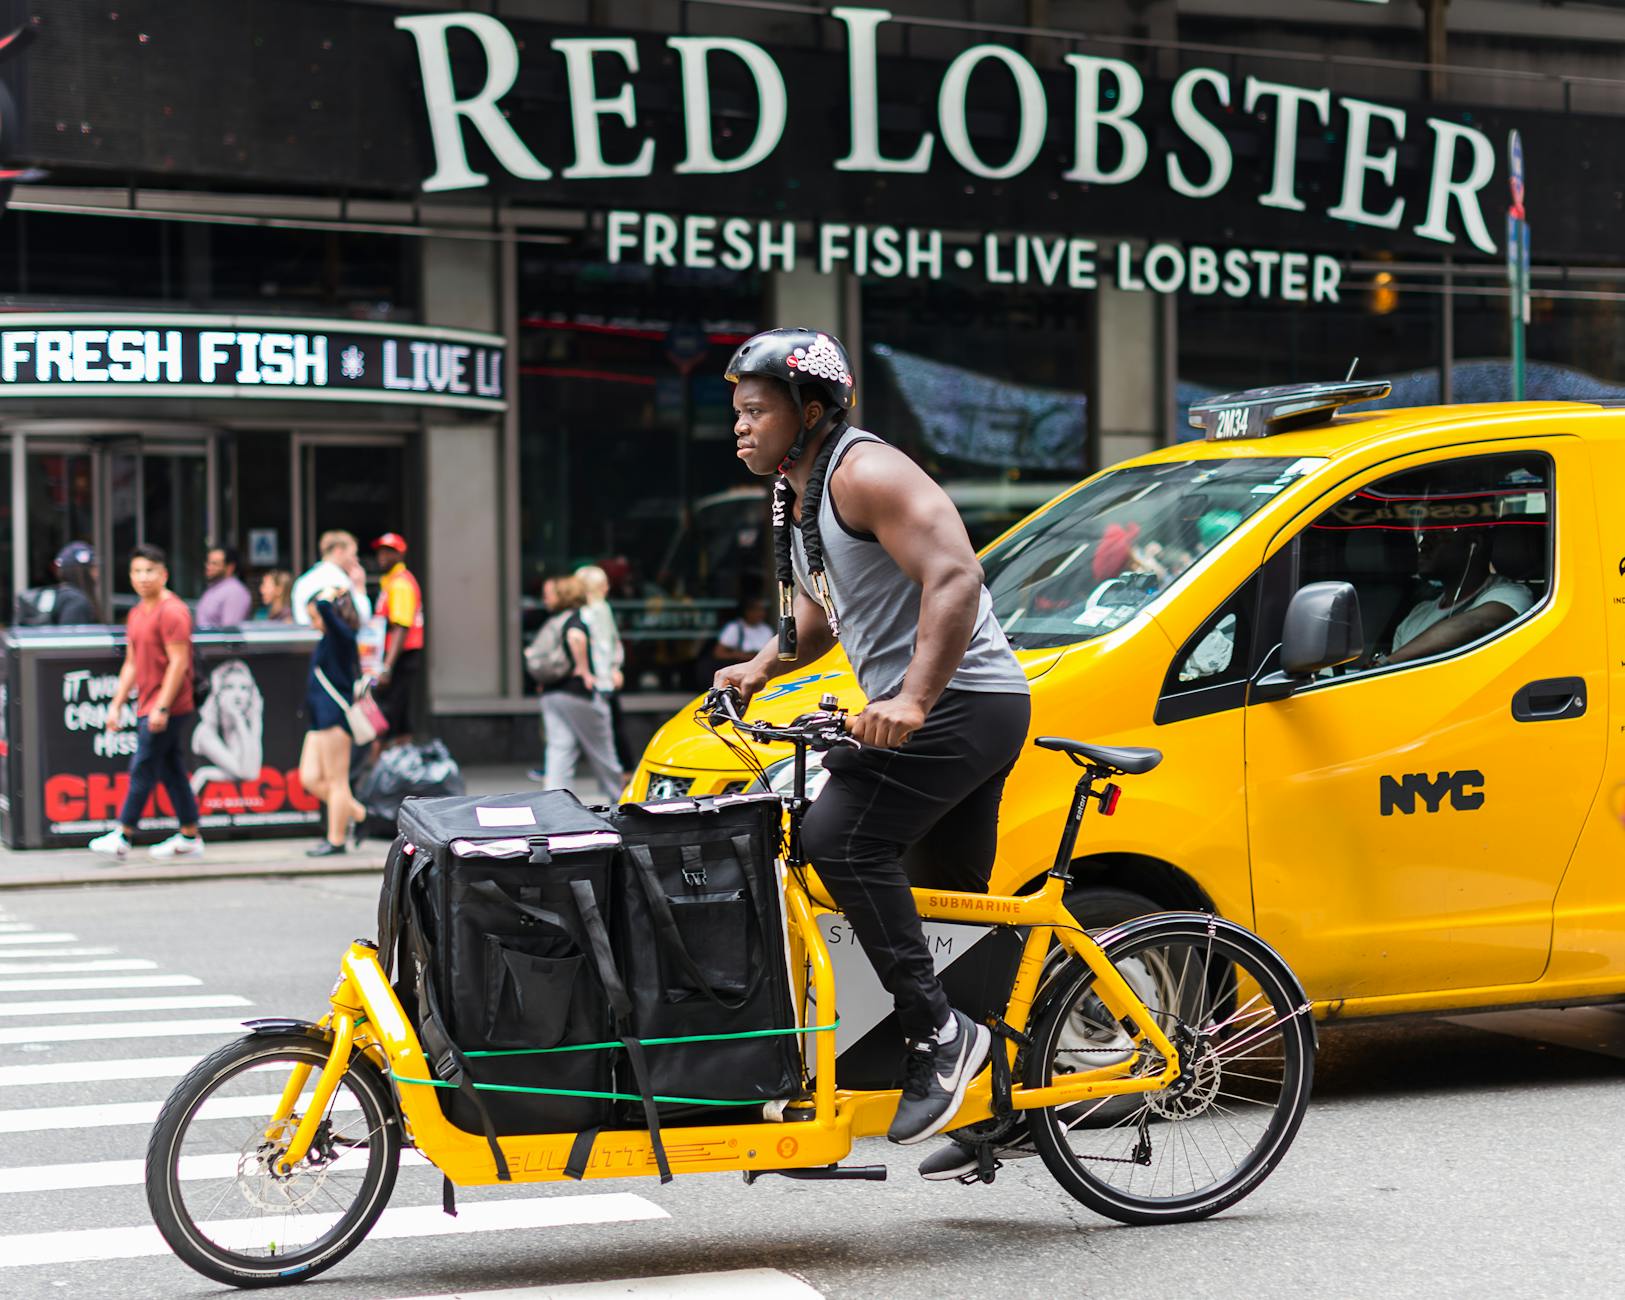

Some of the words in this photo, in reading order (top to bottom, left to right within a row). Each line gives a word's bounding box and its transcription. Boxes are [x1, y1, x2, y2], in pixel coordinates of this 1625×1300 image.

[395, 11, 788, 193] RED
[832, 6, 1498, 255] LOBSTER
[606, 210, 796, 272] FRESH
[818, 223, 943, 280] FISH
[985, 233, 1098, 290] LIVE
[1118, 241, 1342, 303] LOBSTER
[1, 329, 182, 383] FRESH
[199, 331, 328, 386] FISH
[383, 339, 471, 393] LIVE
[1215, 407, 1249, 440] 2M34
[44, 766, 321, 823] CHAGO
[1380, 769, 1485, 816] NYC
[929, 896, 1021, 914] SUBMARINE
